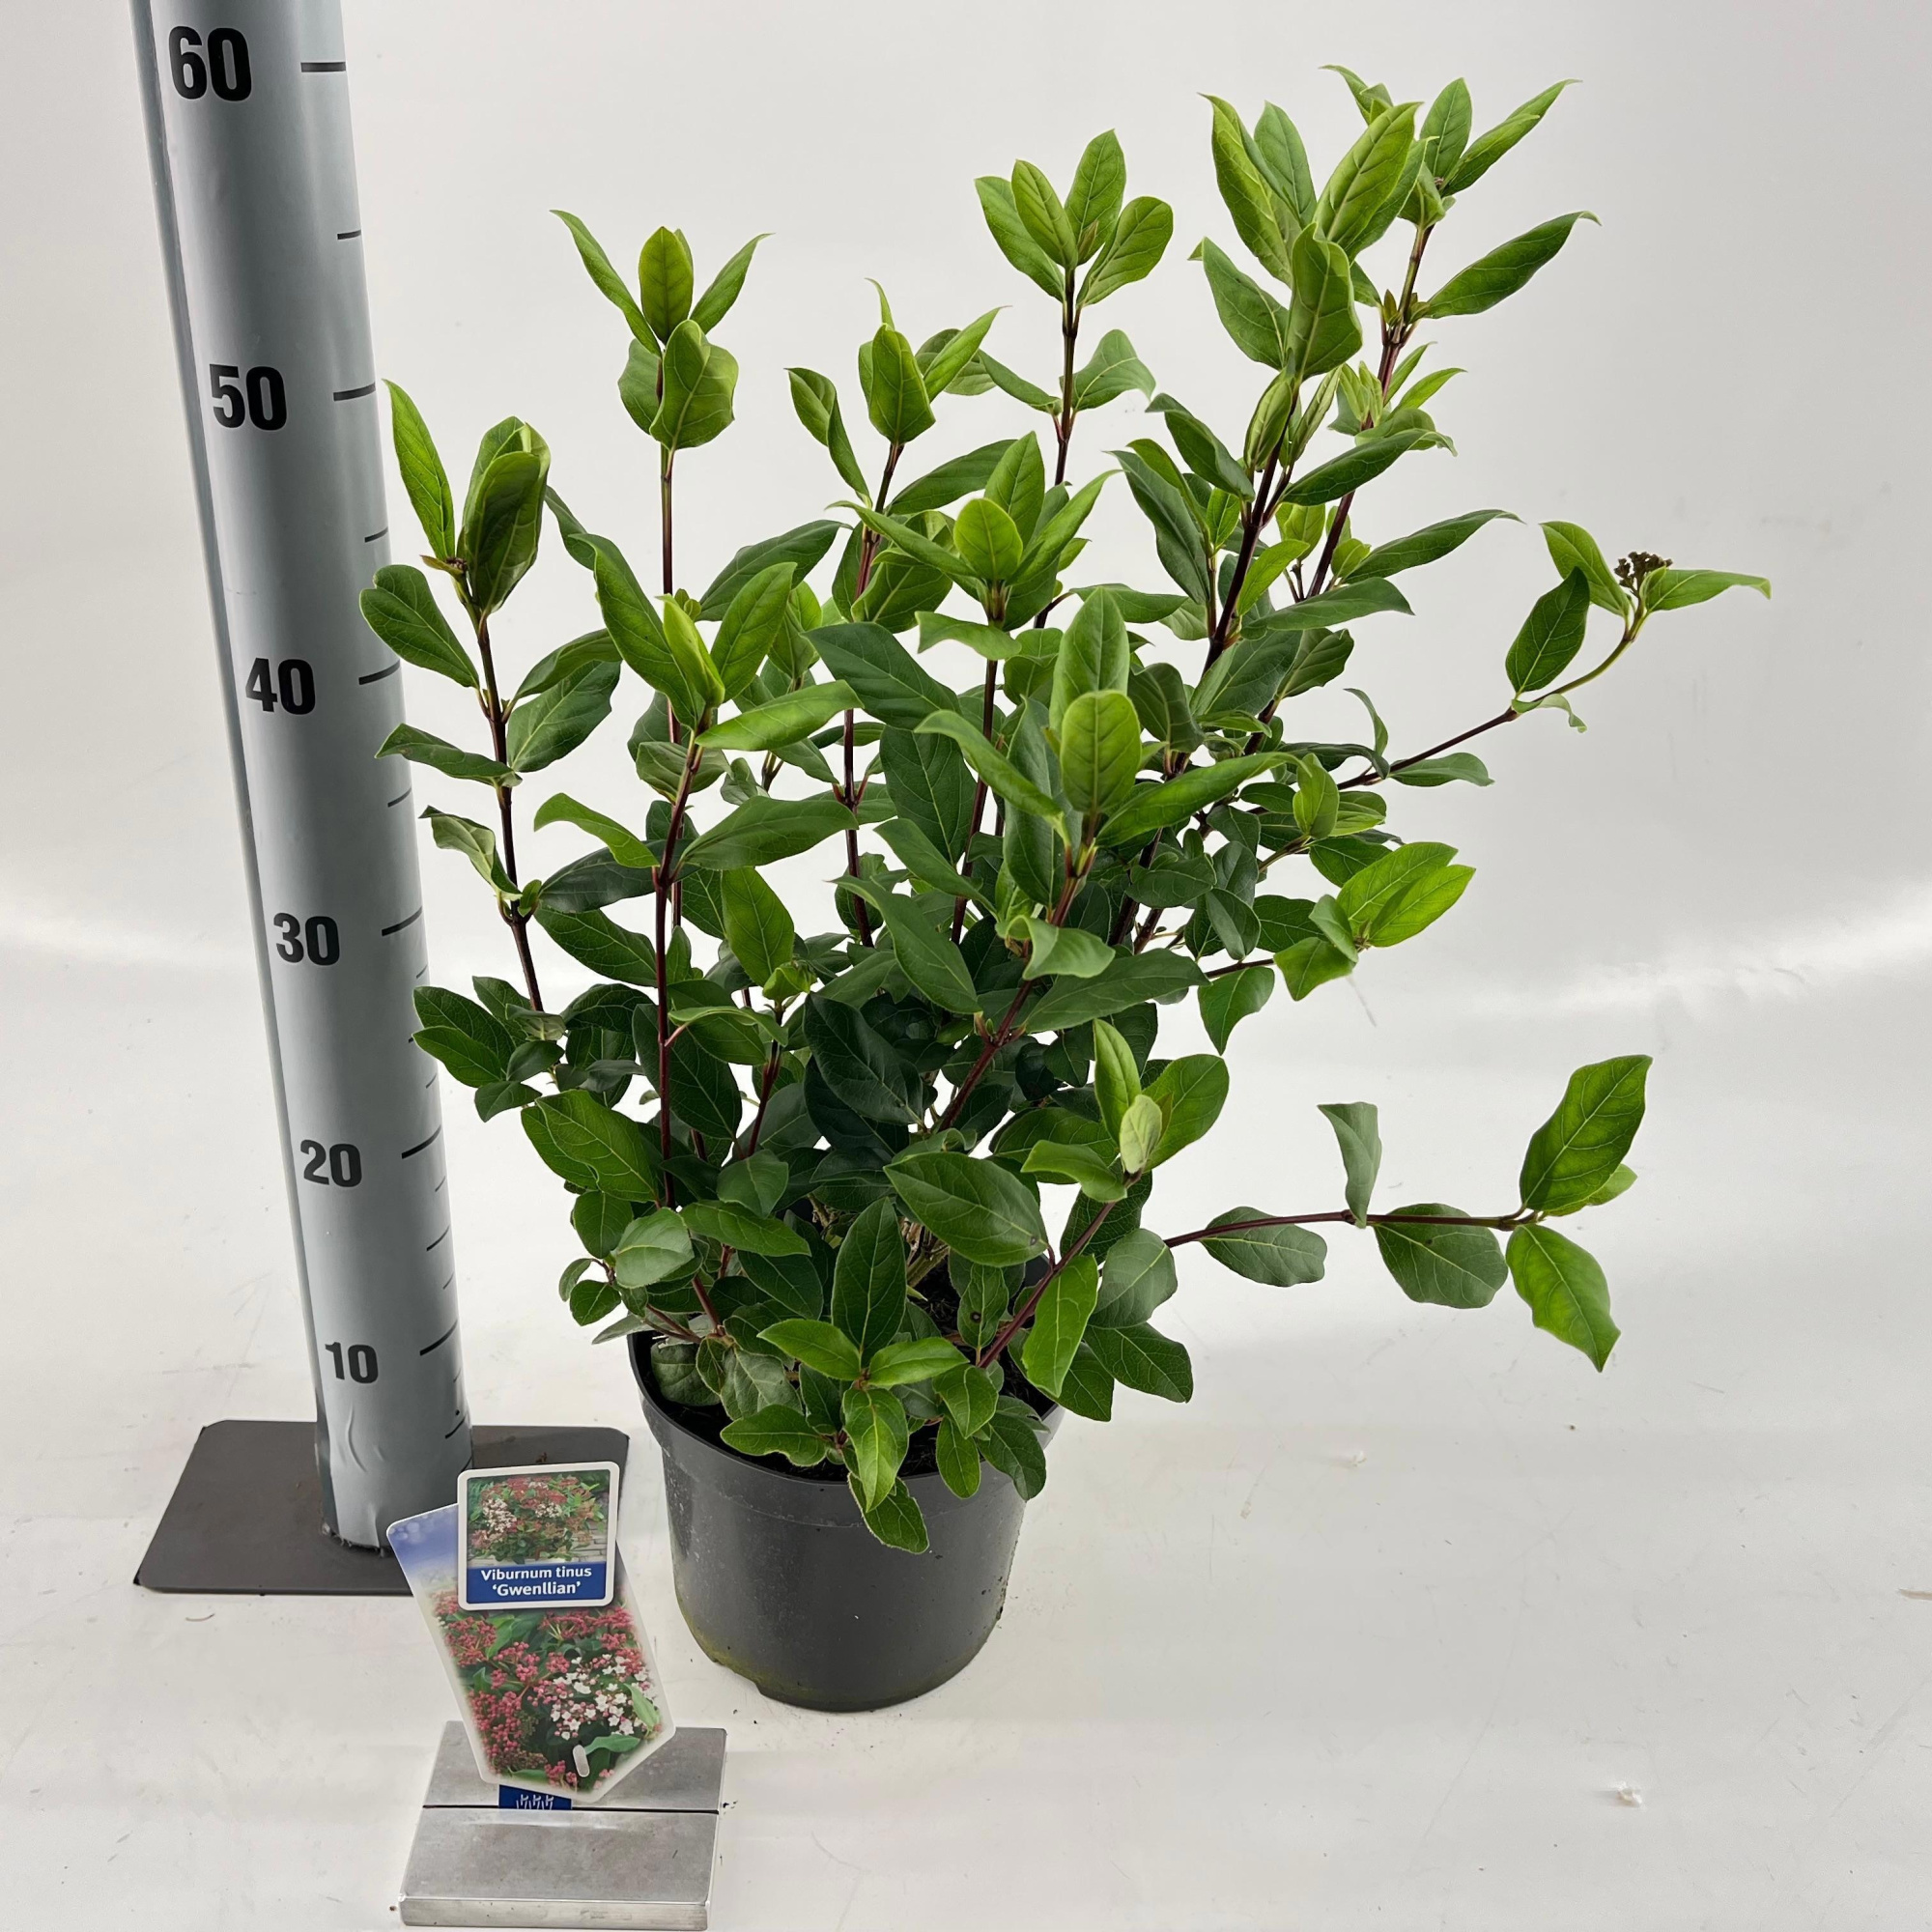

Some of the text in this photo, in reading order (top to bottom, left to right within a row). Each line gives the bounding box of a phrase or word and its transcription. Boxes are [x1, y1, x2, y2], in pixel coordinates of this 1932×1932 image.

[169, 26, 252, 101] 60
[209, 364, 286, 431] 50
[246, 657, 315, 715] 40
[274, 911, 339, 965] 30
[300, 1139, 360, 1187] 20
[325, 1342, 379, 1383] 10
[481, 1566, 592, 1581] Viburnum tinus
